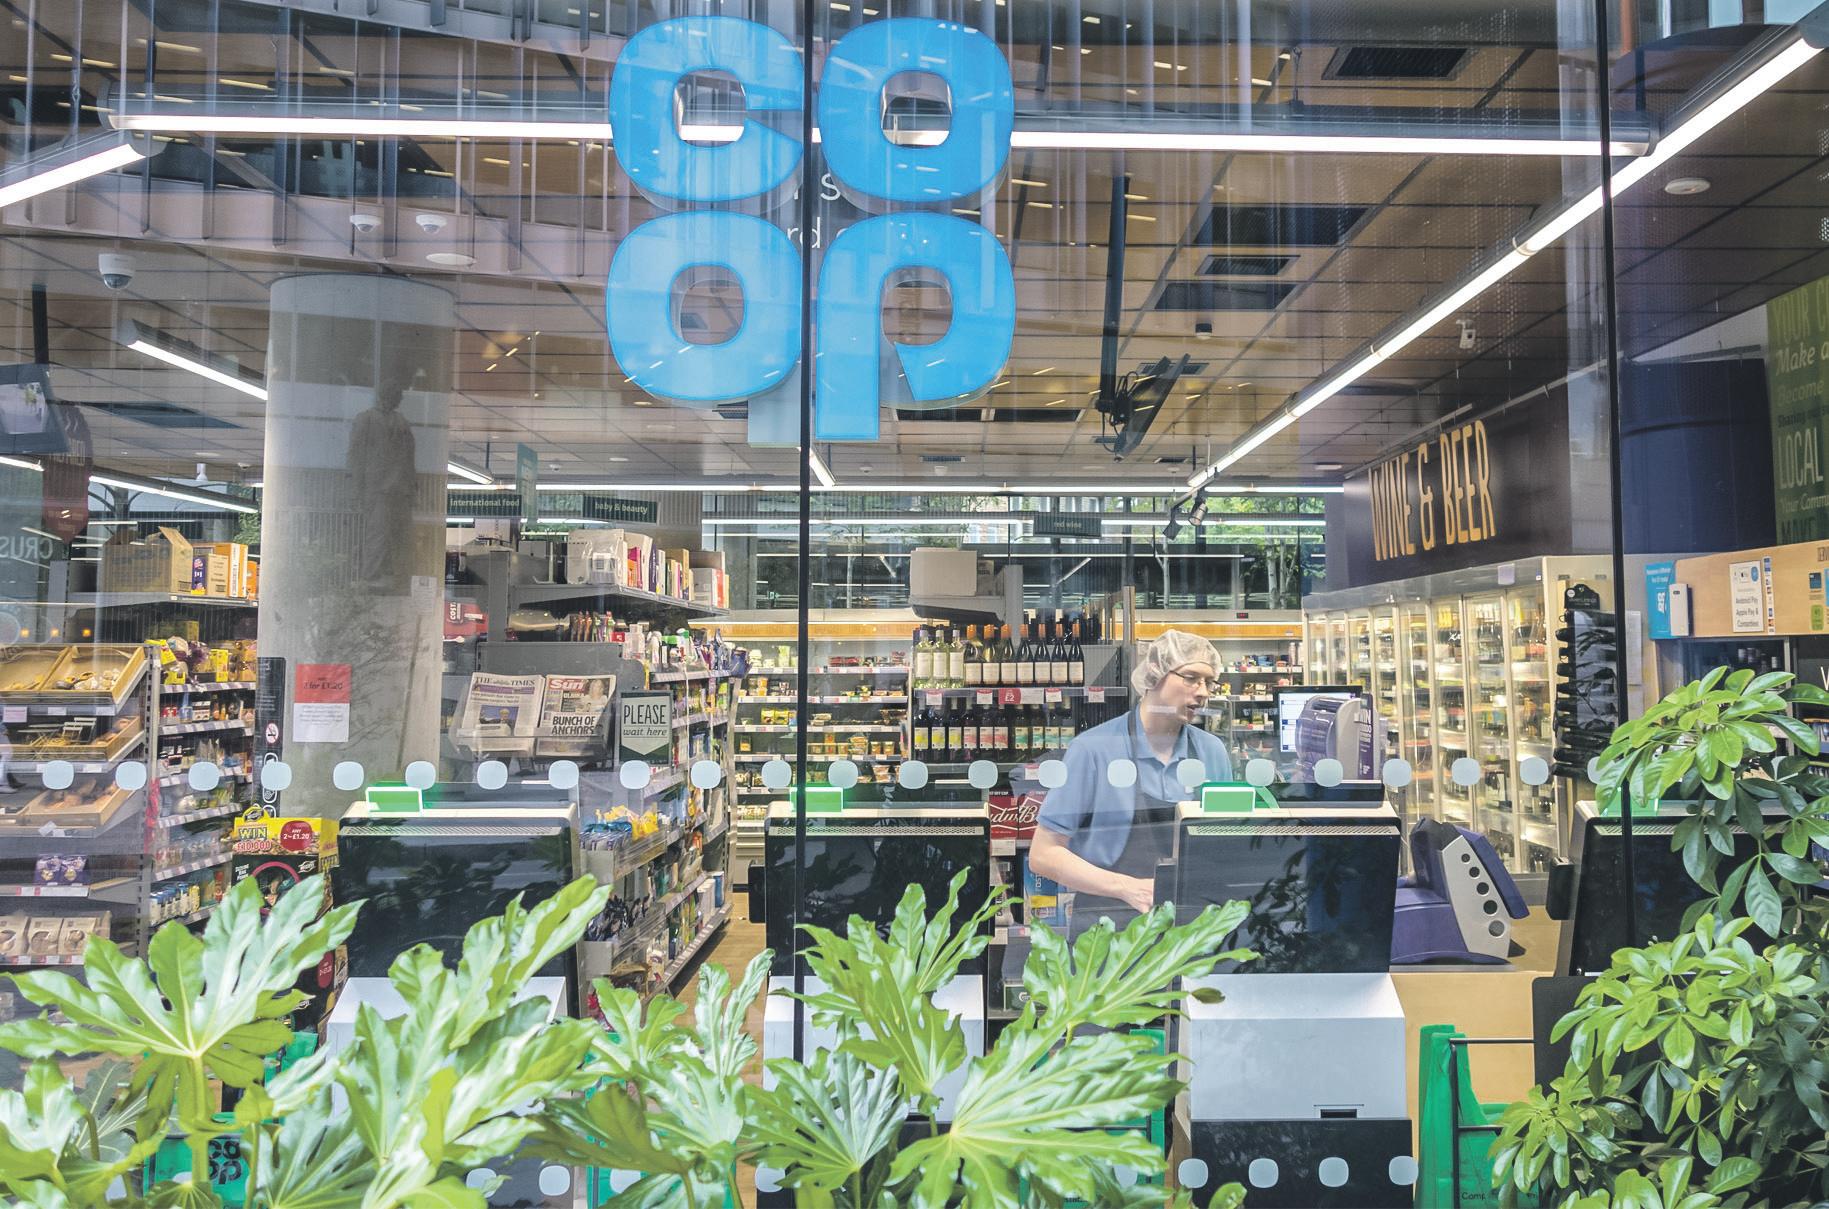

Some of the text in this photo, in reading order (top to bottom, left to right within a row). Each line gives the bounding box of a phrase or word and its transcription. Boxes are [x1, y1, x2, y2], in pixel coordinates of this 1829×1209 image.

[1776, 342, 1816, 376] Make
[1778, 427, 1823, 489] LOCAL
[1368, 420, 1496, 561] WINE & BEER
[450, 498, 520, 507] international food
[595, 501, 613, 512] baby
[621, 504, 648, 515] beauty
[550, 679, 583, 690] Sun
[624, 704, 667, 724] PLEASE
[552, 716, 595, 726] BUNCH OF
[551, 725, 594, 735] ANCHORS
[623, 727, 667, 736] wait here
[239, 827, 267, 840] WIN
